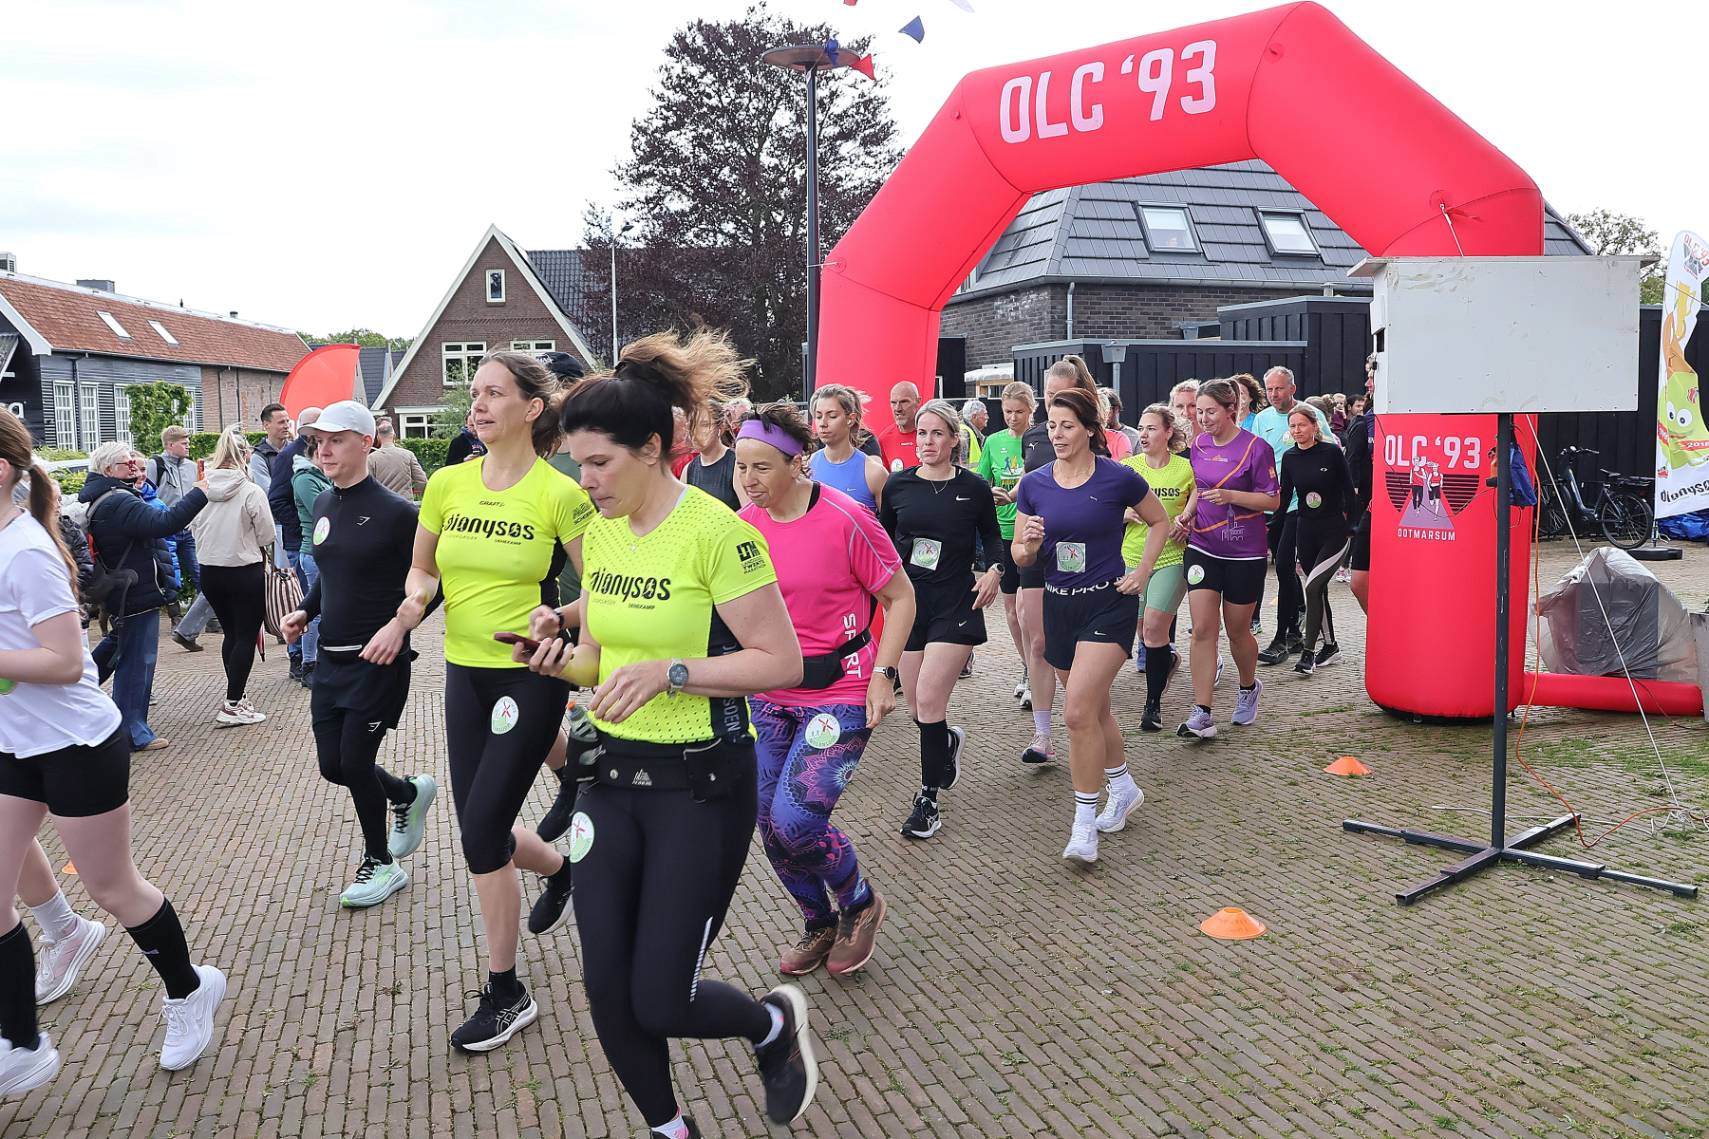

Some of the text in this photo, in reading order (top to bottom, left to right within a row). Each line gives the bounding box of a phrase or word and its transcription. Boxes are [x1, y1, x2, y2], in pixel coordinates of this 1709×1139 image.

[1000, 61, 1105, 143] OLC
[1385, 435, 1427, 467] OLC
[1660, 480, 1709, 503] dionyso
[444, 513, 535, 541] dionysos
[1397, 528, 1456, 541] OOTMARSUM
[1045, 581, 1069, 596] NIKE
[843, 613, 862, 679] SPRT
